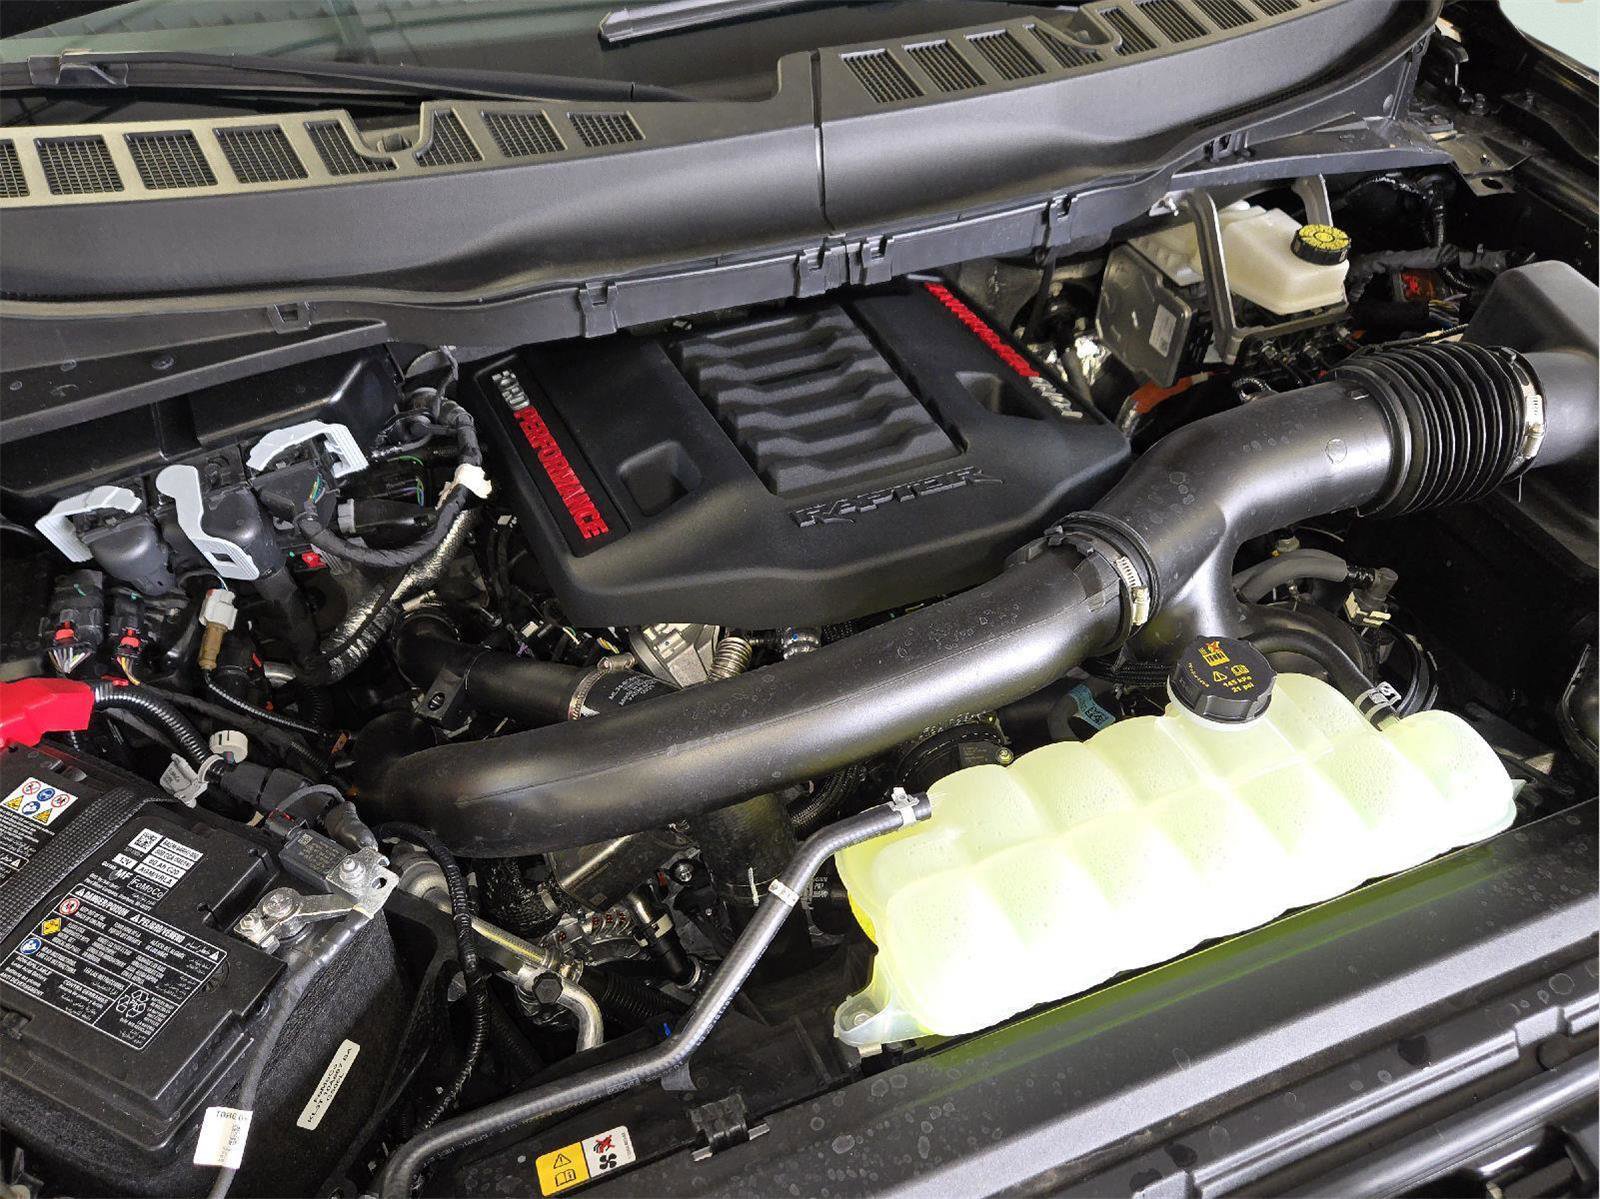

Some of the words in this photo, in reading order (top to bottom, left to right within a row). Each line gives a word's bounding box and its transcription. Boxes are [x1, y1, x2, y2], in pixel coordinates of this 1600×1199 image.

[492, 370, 530, 410] FORD
[514, 405, 609, 540] PERFORMANCE
[788, 465, 1004, 528] RAPTOR
[130, 877, 165, 899] FoMoCo
